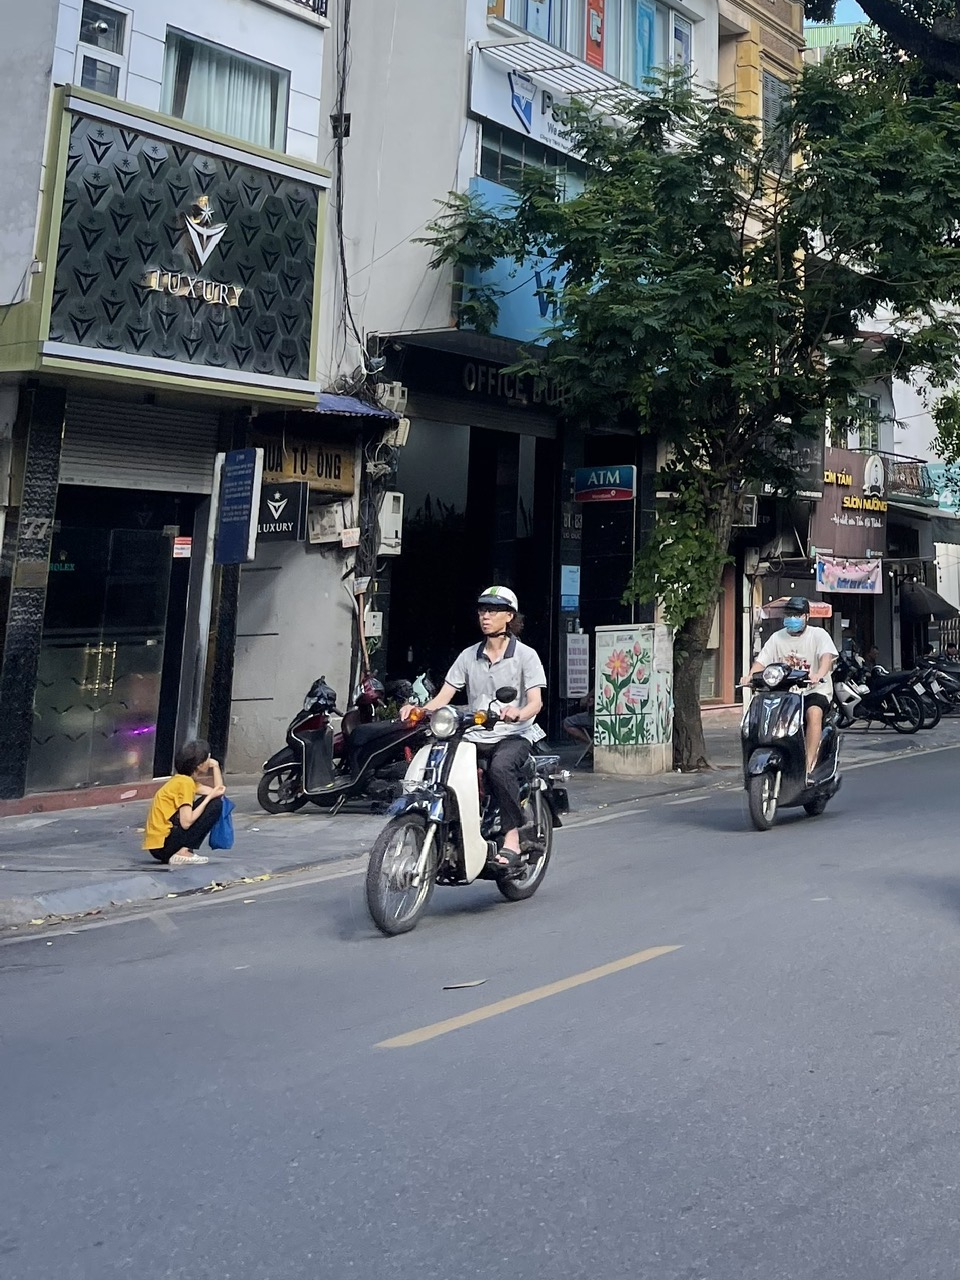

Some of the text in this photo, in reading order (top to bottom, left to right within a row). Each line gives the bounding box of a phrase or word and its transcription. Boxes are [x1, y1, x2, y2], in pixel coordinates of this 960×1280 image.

[147, 269, 243, 307] LUXURY
[464, 362, 527, 400] OFFICE
[263, 443, 283, 472] UA
[587, 469, 620, 485] ATM
[257, 522, 294, 533] LUXURY
